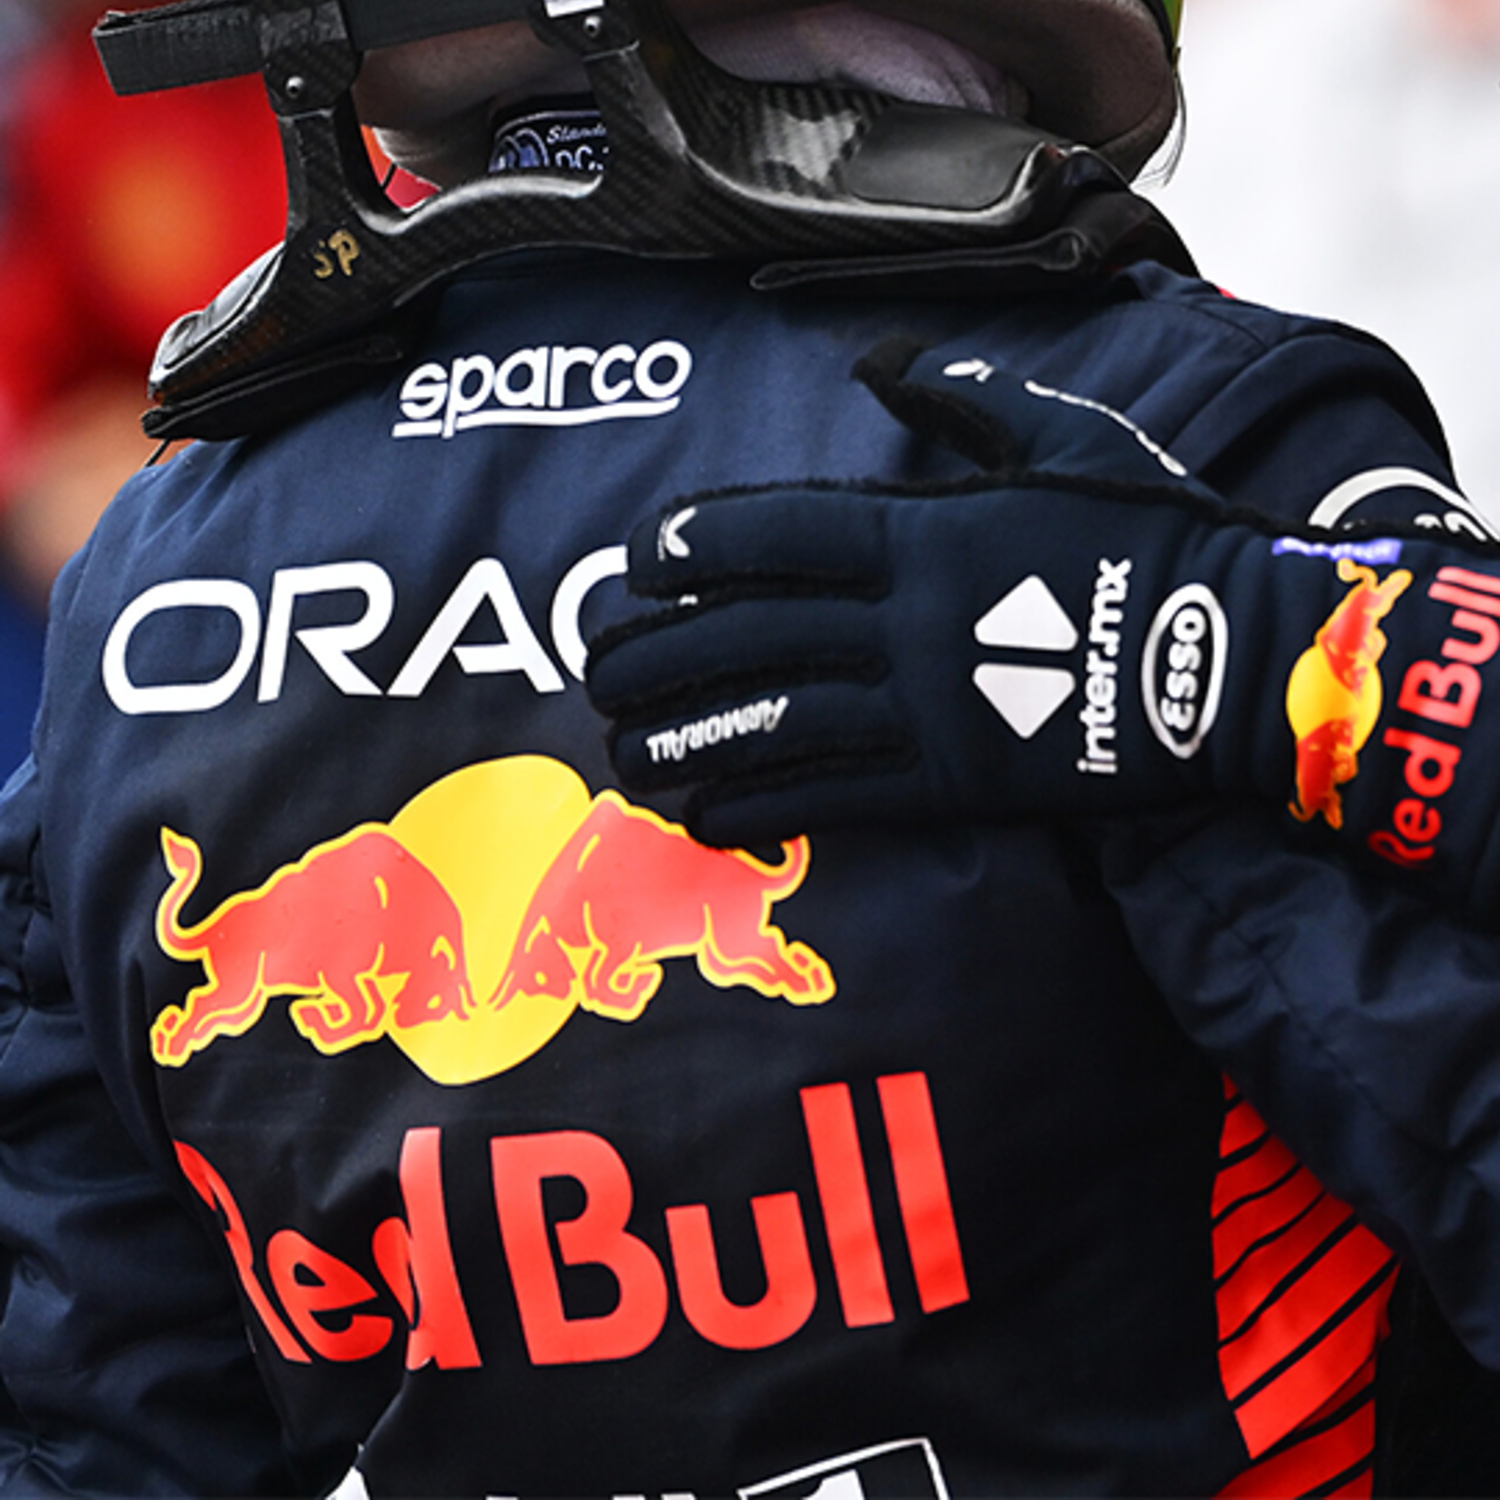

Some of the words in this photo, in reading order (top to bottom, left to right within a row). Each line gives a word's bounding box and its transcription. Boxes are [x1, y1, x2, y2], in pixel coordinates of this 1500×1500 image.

[396, 340, 692, 438] sparco
[1077, 558, 1131, 775] inter.mx
[1367, 728, 1461, 868] Red
[490, 1072, 970, 1366] Bull
